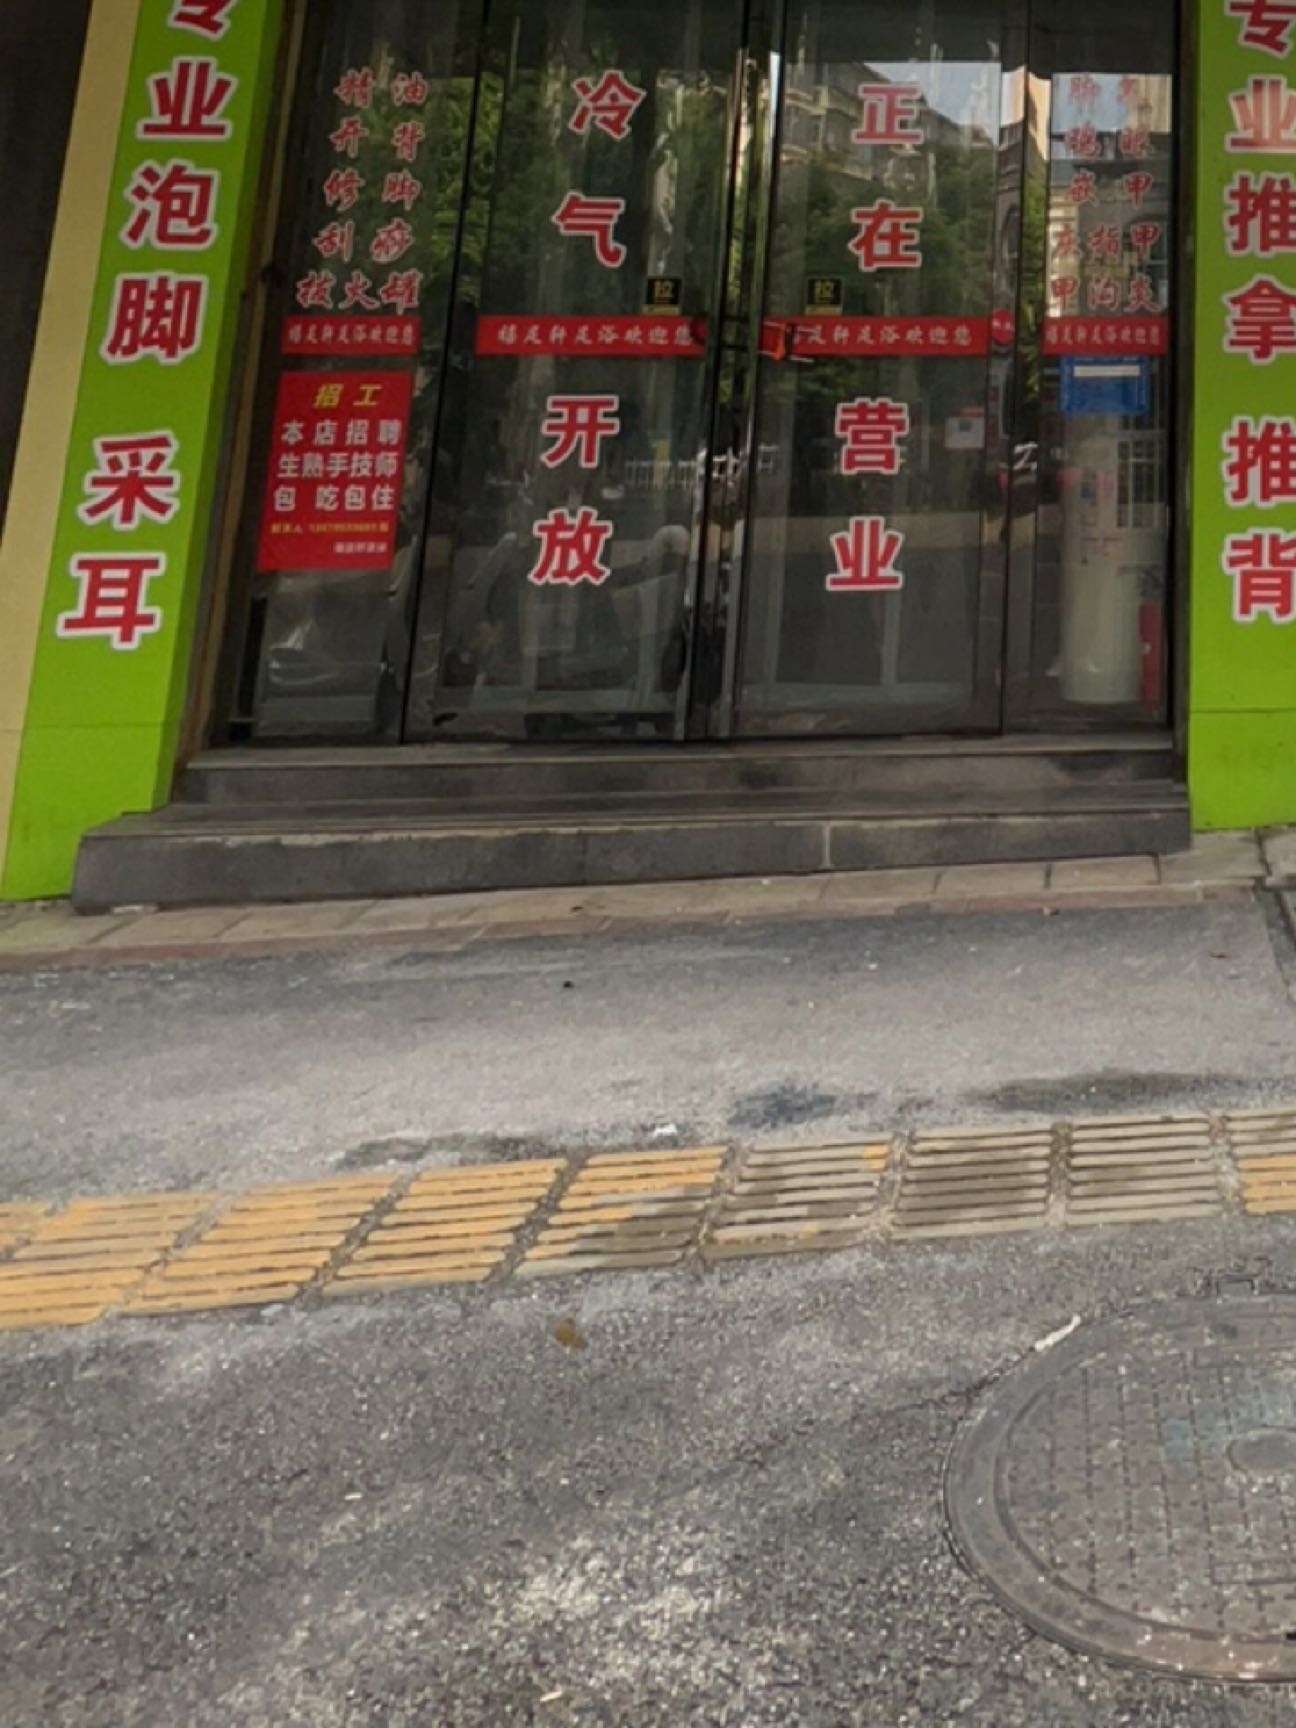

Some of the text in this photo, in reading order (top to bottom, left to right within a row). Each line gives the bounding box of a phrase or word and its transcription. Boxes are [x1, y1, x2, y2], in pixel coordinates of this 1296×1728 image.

[333, 67, 428, 108] 精油
[329, 115, 426, 161] 开背
[324, 168, 422, 212] 修脚
[313, 217, 415, 263] 刮痧
[296, 268, 423, 314] 拔火罐
[313, 383, 382, 409] 招工
[281, 419, 402, 446] 本店招聘
[56, 432, 179, 651] 采耳
